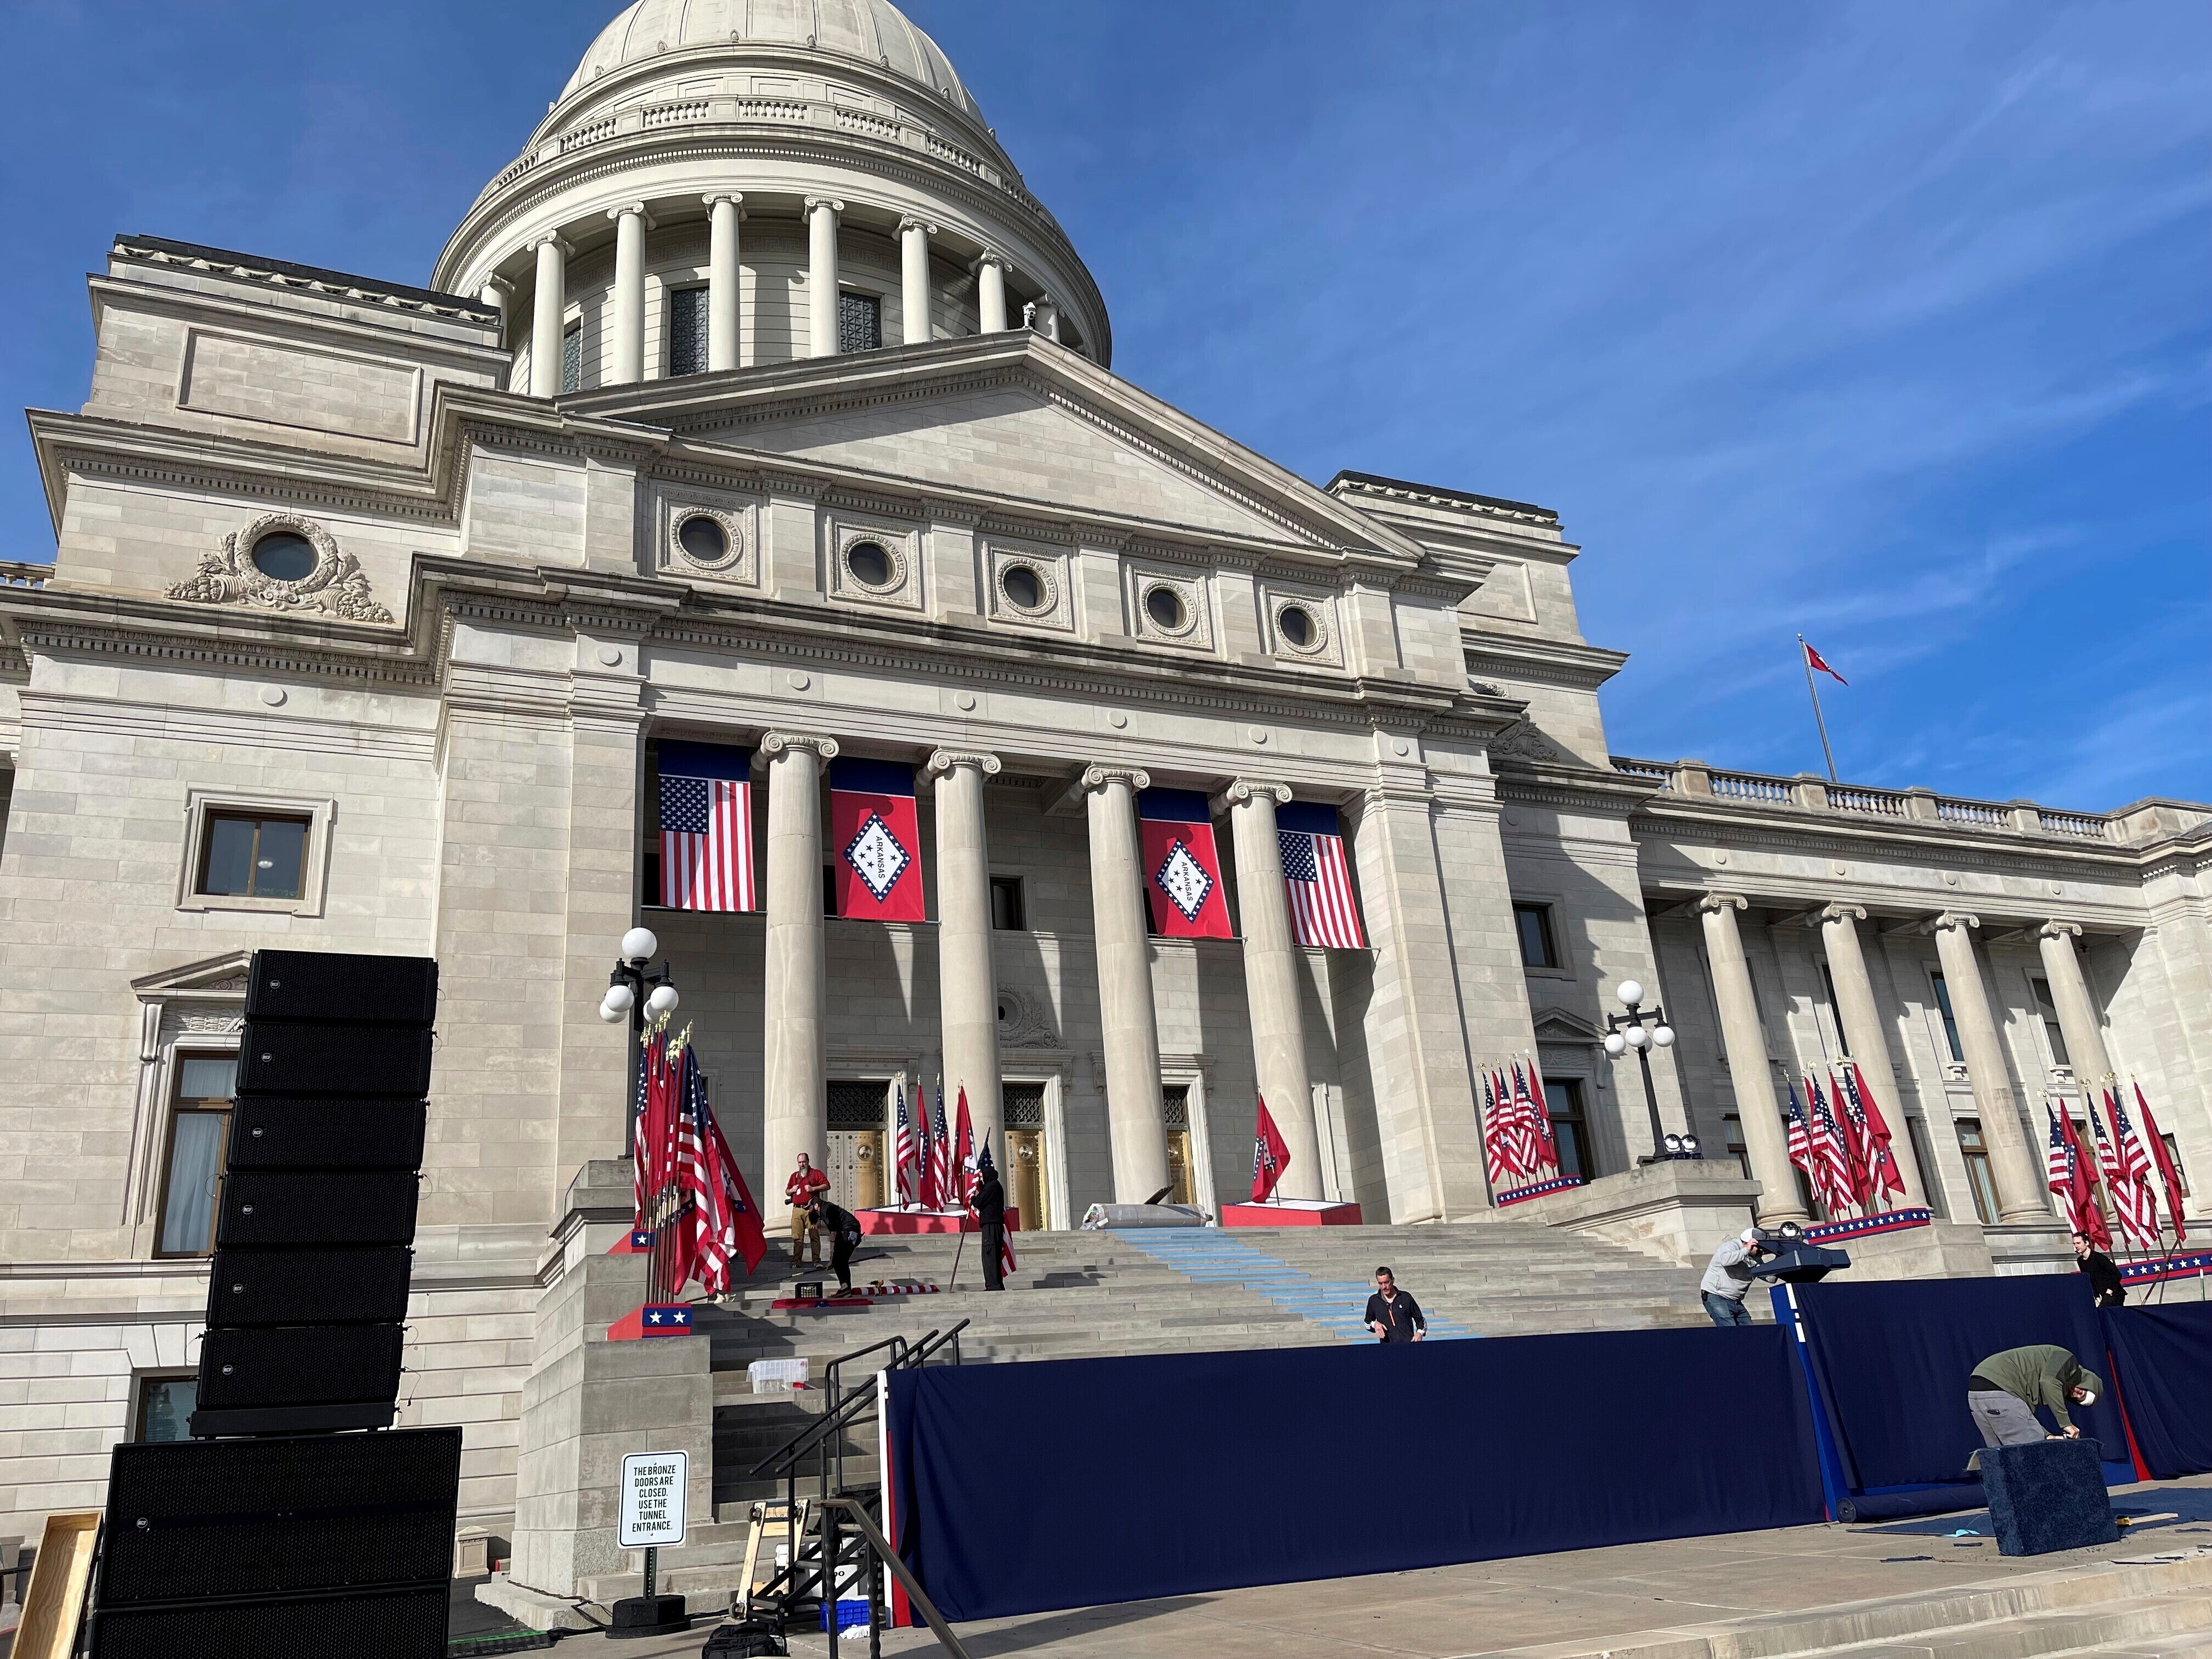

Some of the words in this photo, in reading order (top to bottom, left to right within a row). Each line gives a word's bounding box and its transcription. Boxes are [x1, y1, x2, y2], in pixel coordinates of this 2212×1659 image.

[876, 836, 885, 879] ARKANSAS
[1181, 861, 1193, 901] ARKANSAS
[634, 1466, 647, 1476] THE
[648, 1465, 676, 1475] BRONZE
[635, 1477, 658, 1487] DOORS
[659, 1476, 674, 1485] ARE
[639, 1487, 668, 1498] CLOSED.
[639, 1499, 653, 1509] USE
[653, 1498, 667, 1508] THE
[639, 1510, 667, 1520] TUNNEL
[632, 1520, 673, 1532] ENTRANCE.
